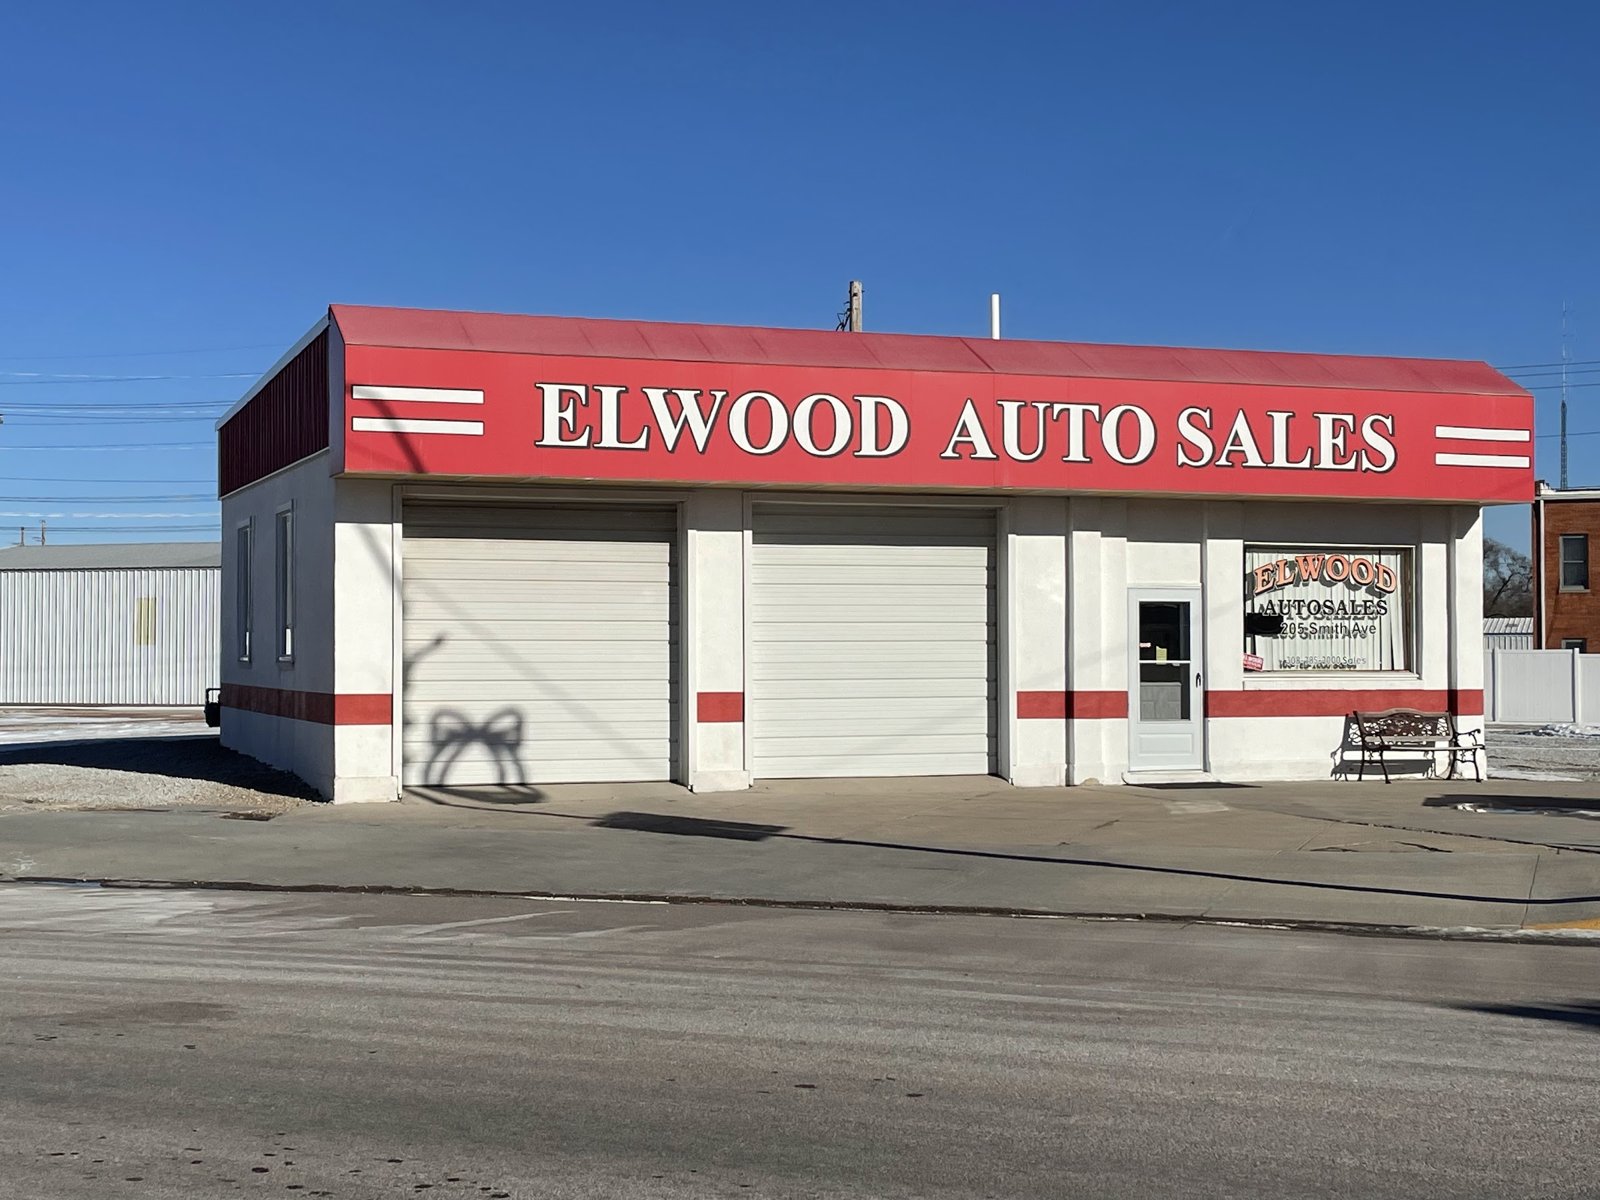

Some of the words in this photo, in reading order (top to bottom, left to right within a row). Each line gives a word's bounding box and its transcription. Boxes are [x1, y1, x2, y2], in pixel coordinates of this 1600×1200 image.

[535, 382, 910, 458] ELWOOD
[940, 398, 1156, 465] AUTO
[1176, 406, 1396, 473] SALES
[1254, 554, 1397, 595] ELWOOD
[1263, 599, 1388, 616] AUTOSALES
[1281, 621, 1304, 635] 205
[1308, 621, 1346, 635] Smith
[1352, 622, 1377, 635] Ave
[1343, 656, 1366, 665] Sales
